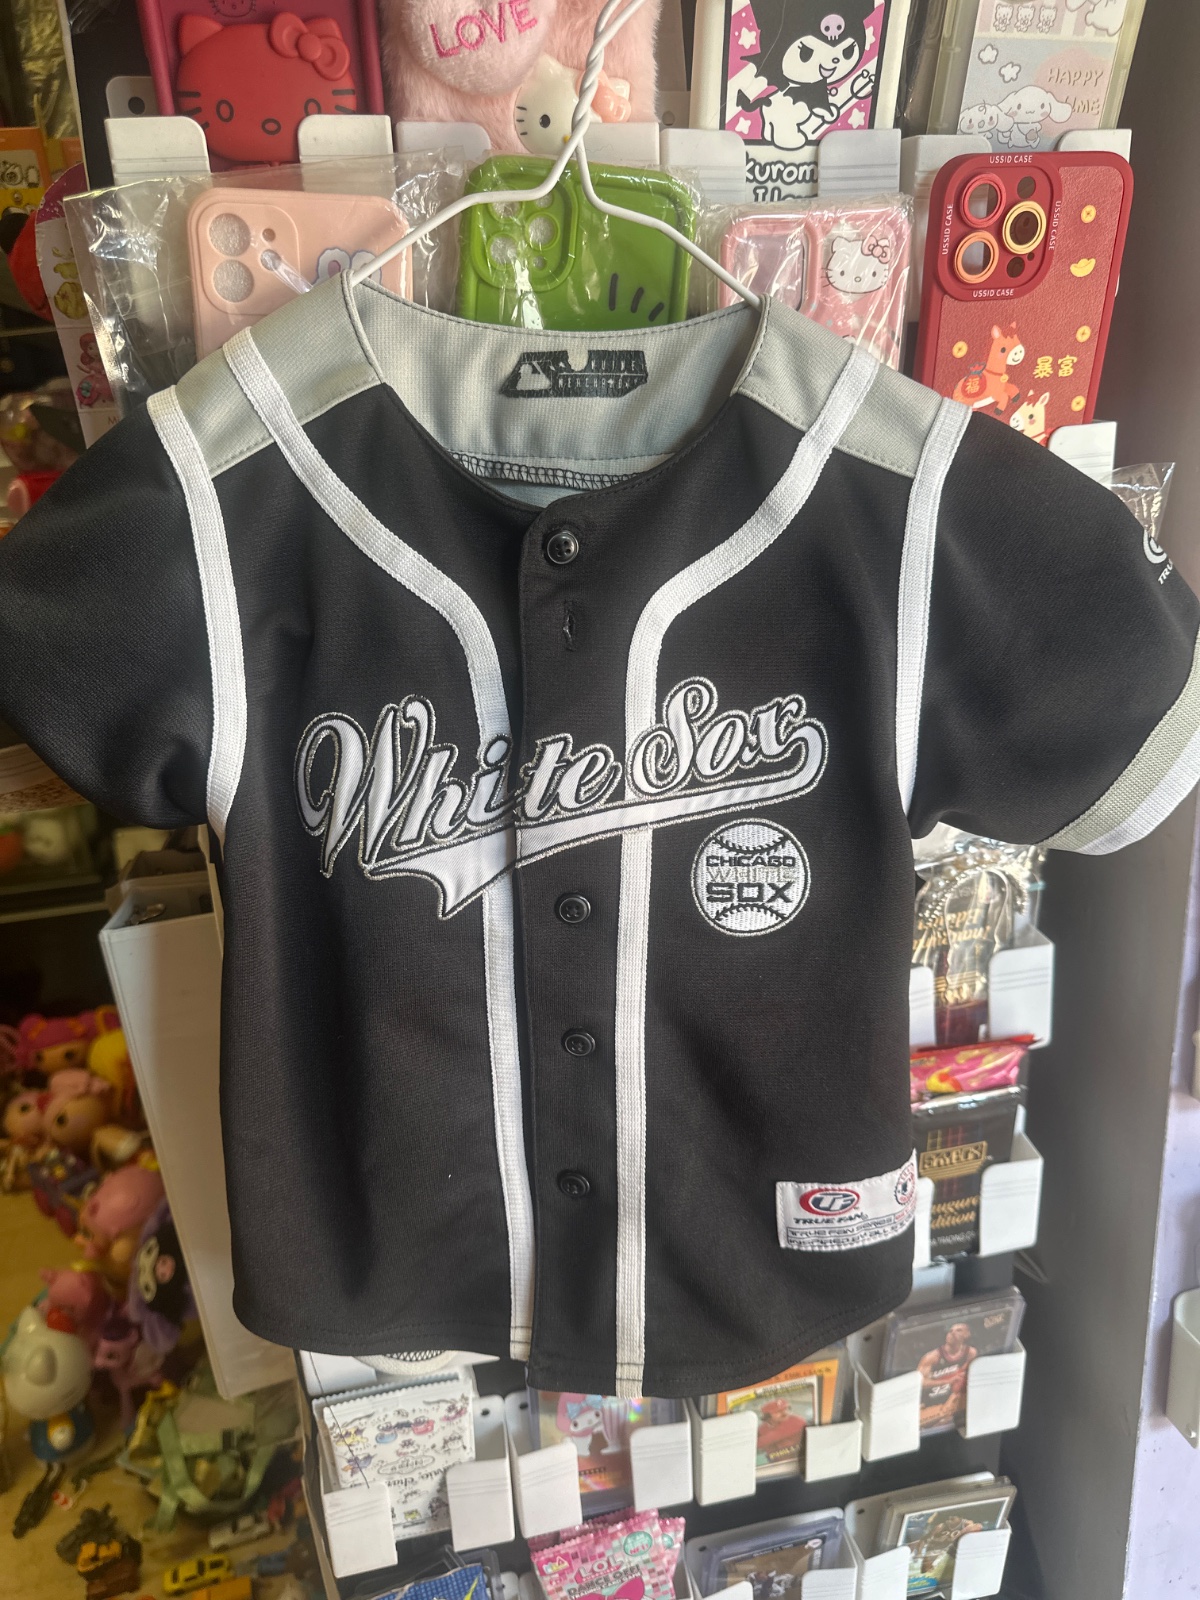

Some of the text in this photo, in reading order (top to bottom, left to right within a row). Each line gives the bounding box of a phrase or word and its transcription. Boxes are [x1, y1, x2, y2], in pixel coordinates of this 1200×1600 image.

[428, 0, 540, 58] LOVE
[1048, 68, 1104, 87] HAPPY
[989, 154, 1033, 164] USSID CASE
[942, 204, 954, 255] USSID CASE
[1048, 200, 1062, 251] USSID CASE
[972, 288, 1015, 298] USSID CASE
[1033, 355, 1078, 378] 暴富
[966, 377, 981, 394] 福
[293, 676, 829, 878] White Sox
[706, 855, 796, 867] CHICAGO
[706, 867, 797, 882] WHITE
[706, 882, 794, 903] SOX
[793, 1217, 835, 1225] TRUE
